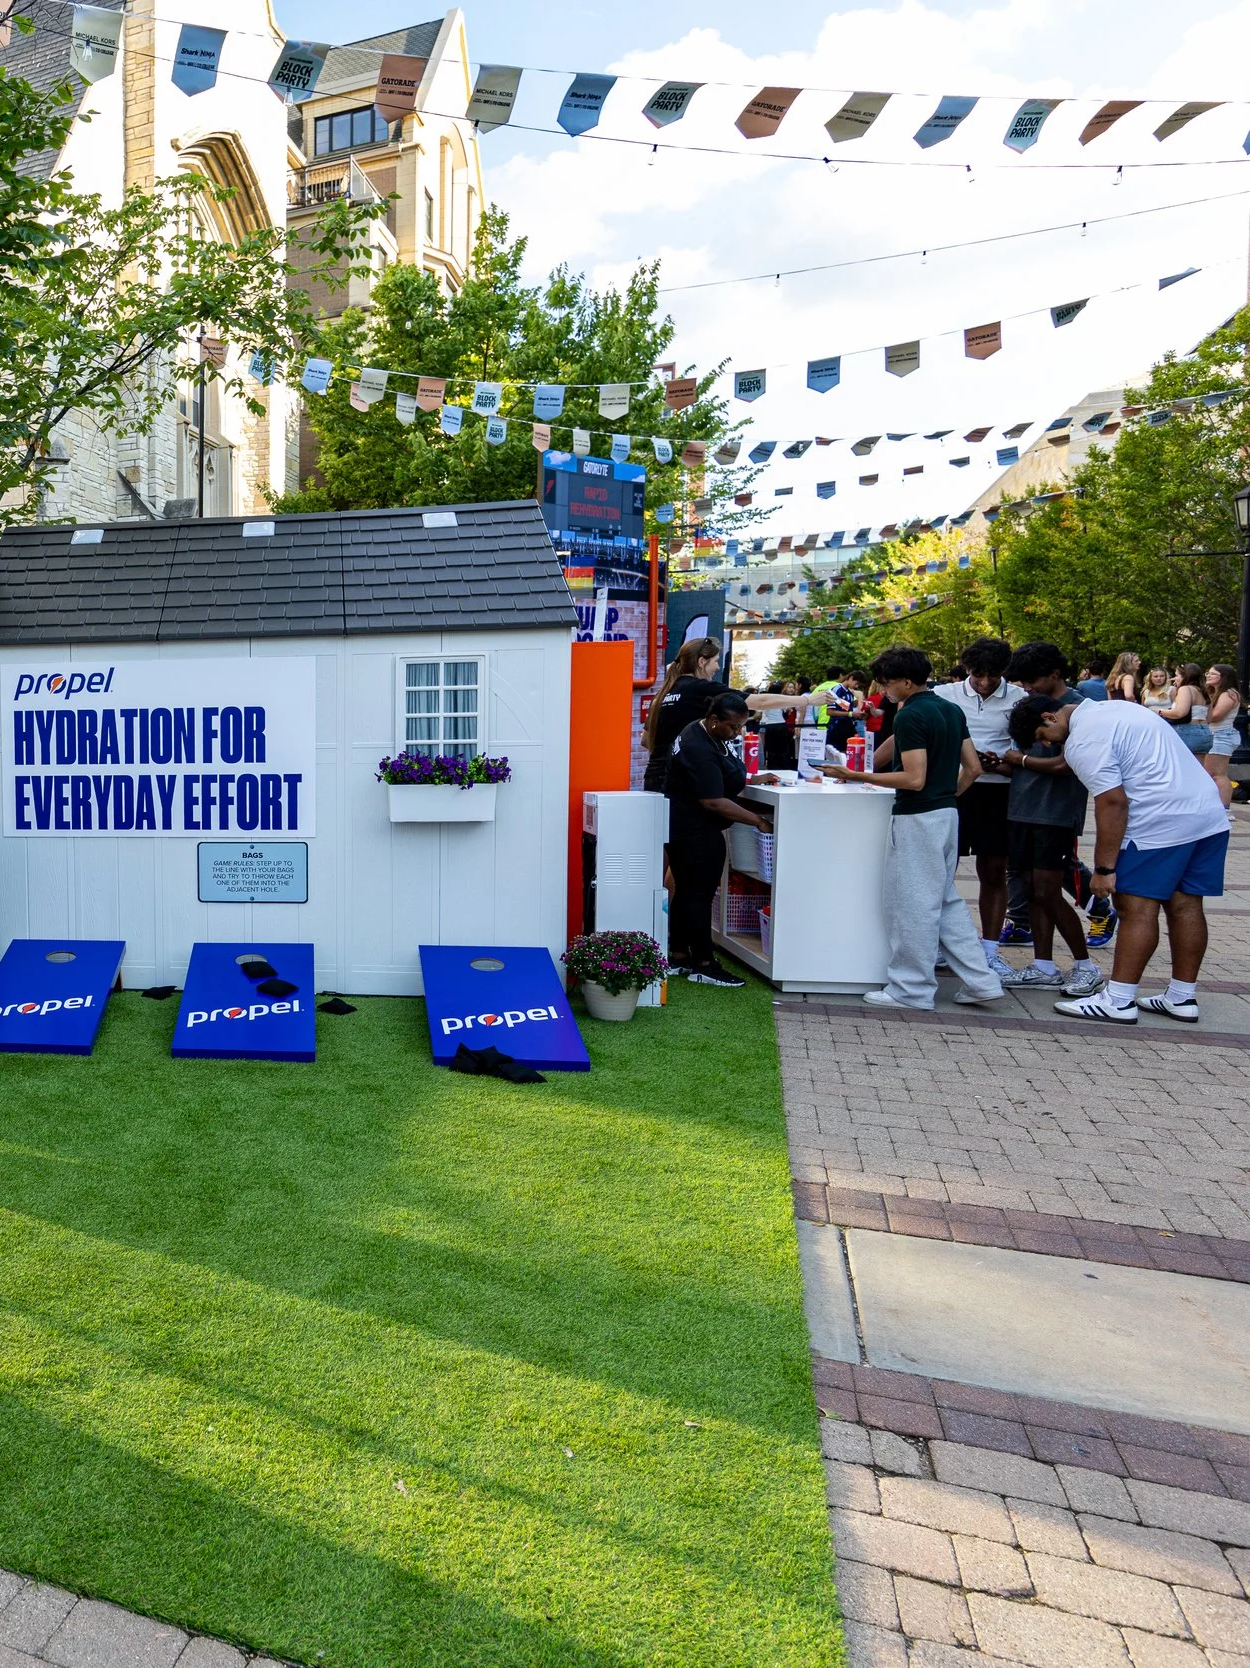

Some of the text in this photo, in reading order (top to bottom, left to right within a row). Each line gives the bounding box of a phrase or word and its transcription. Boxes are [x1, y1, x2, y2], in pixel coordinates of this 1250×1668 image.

[75, 31, 116, 46] MICHAEL KORS
[180, 47, 199, 57] Shark
[280, 61, 314, 78] BLOCK
[275, 71, 310, 89] PARTY
[381, 77, 417, 88] GATORADE
[476, 88, 498, 97] MICHAEL
[657, 91, 688, 102] BLOCK
[651, 101, 684, 112] PARTY
[751, 100, 786, 113] GATORADE
[1014, 117, 1042, 128] BLOCK
[1009, 128, 1038, 139] PARTY
[739, 379, 761, 387] BLOCK
[739, 386, 762, 395] PARTY
[477, 394, 496, 402] BLOCK
[475, 401, 496, 409] PARTY
[583, 461, 609, 477] GATORLYTE
[14, 667, 115, 700] propel
[13, 706, 266, 766] HYDRATION FOR
[748, 746, 759, 757] G
[14, 773, 302, 831] EVERYDAY EFFORT
[186, 999, 301, 1028] propel
[441, 1005, 560, 1035] propel
